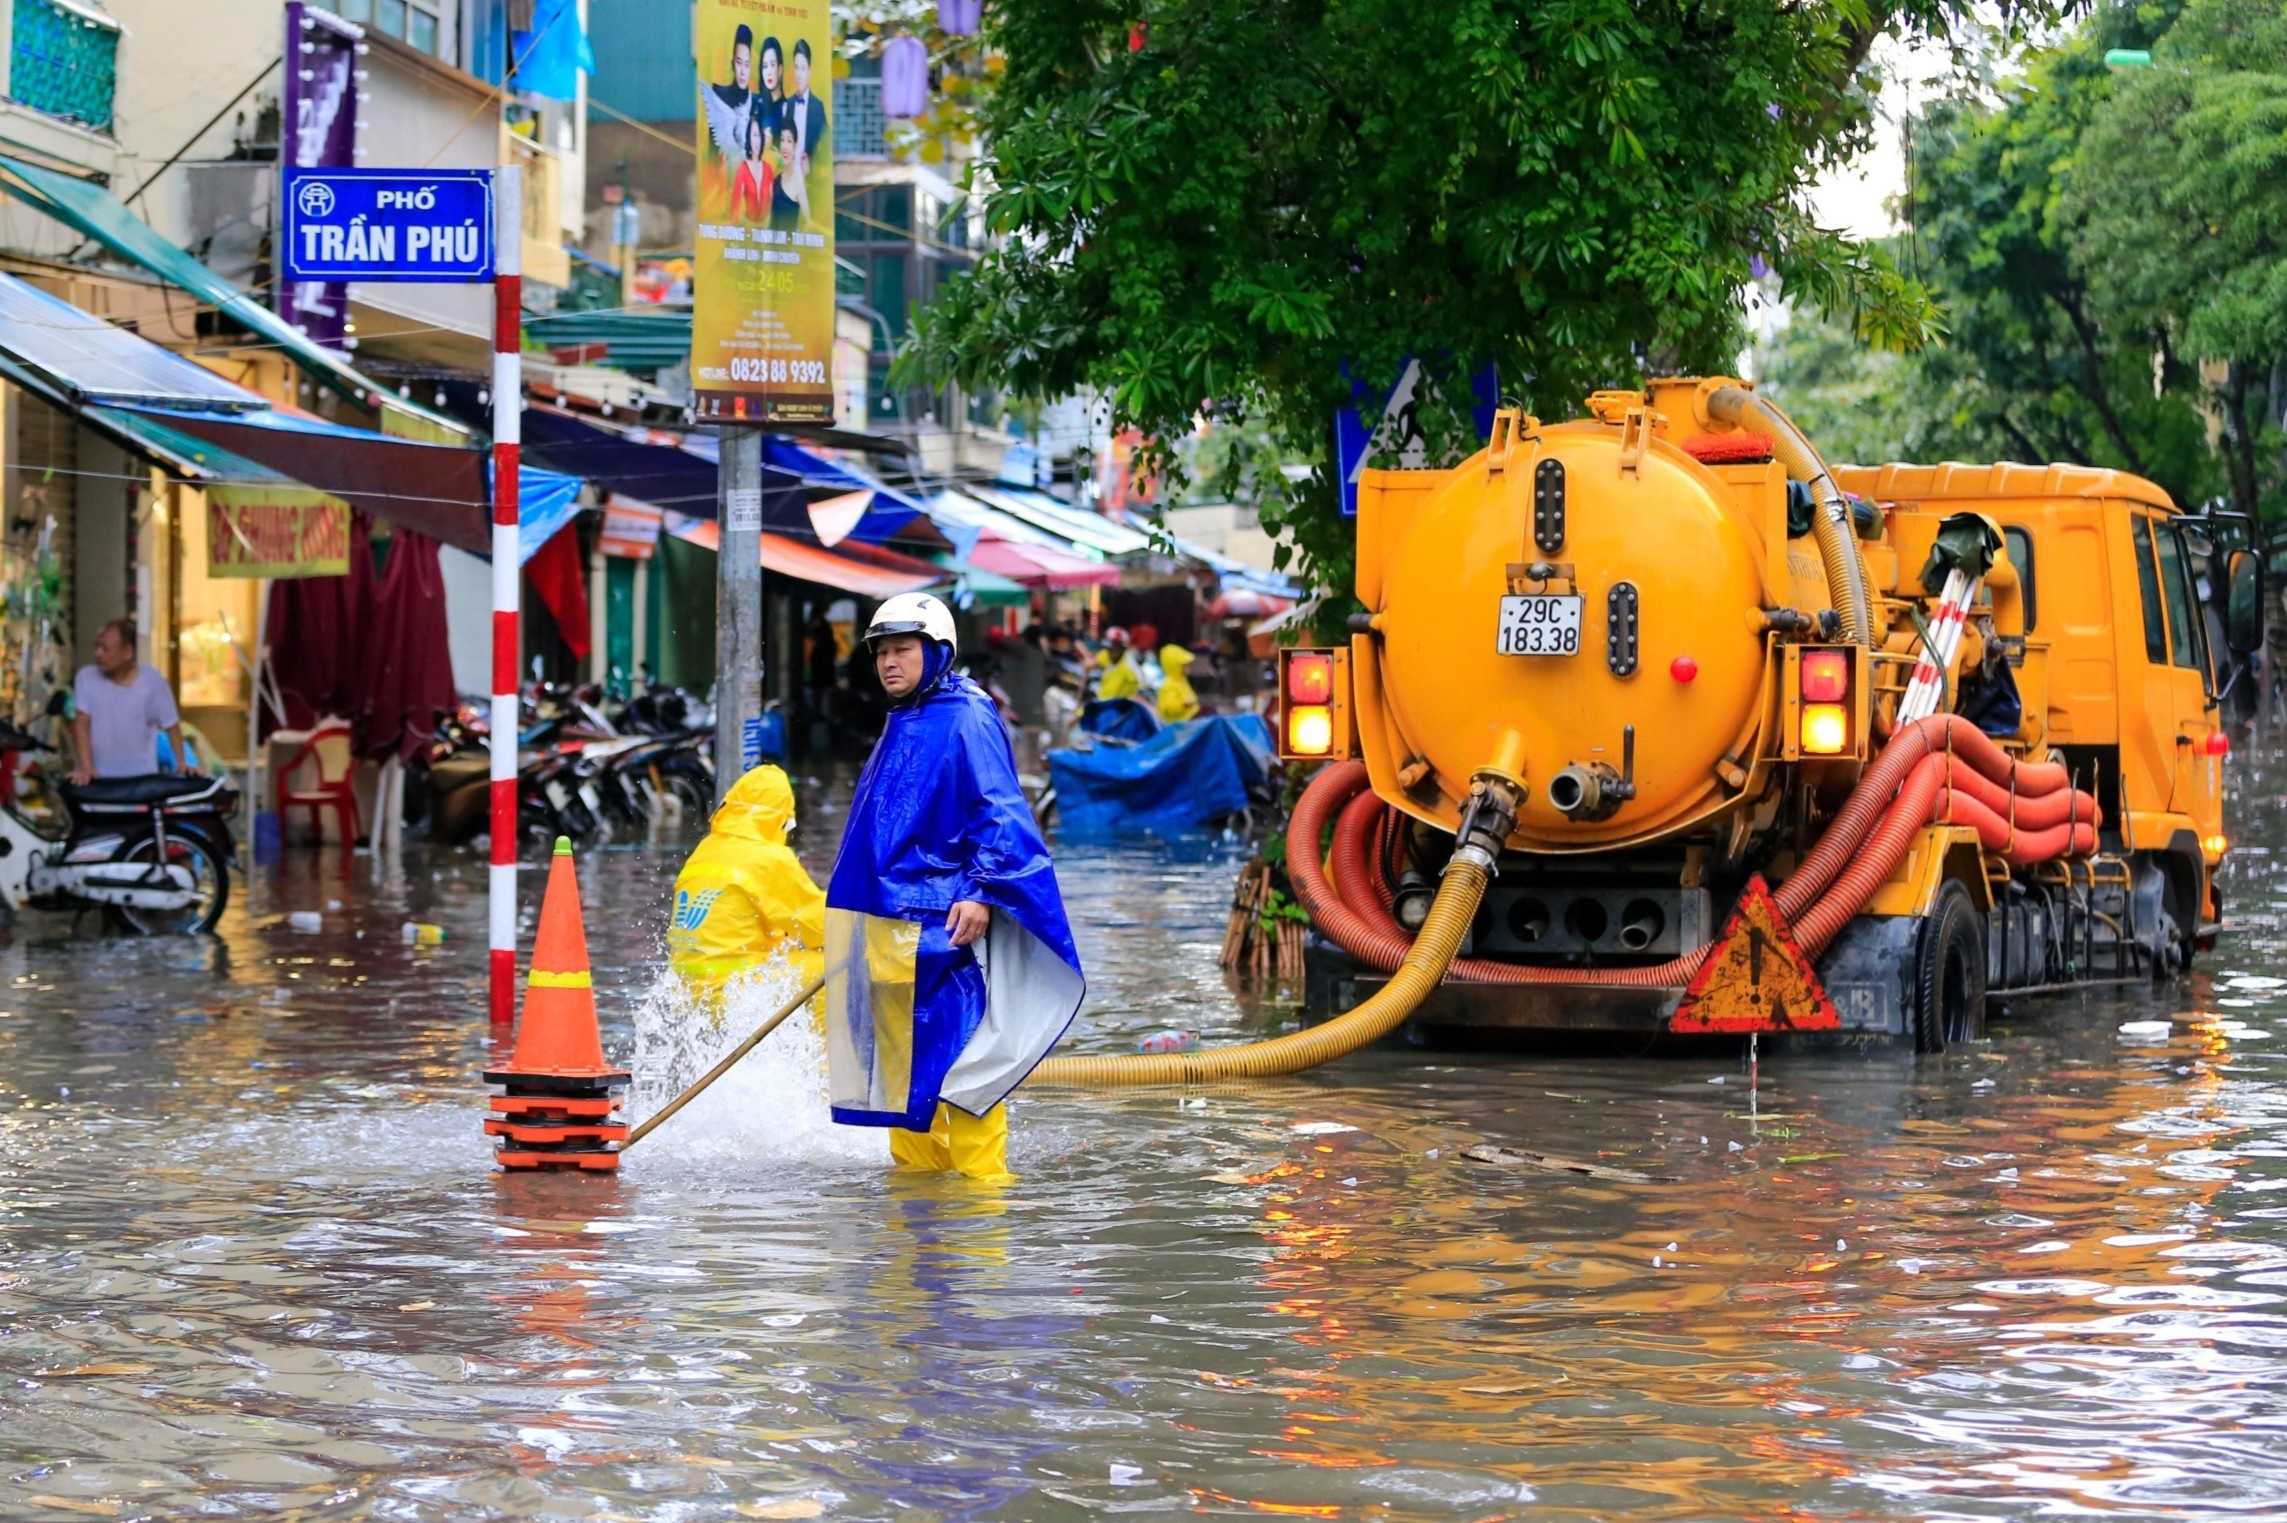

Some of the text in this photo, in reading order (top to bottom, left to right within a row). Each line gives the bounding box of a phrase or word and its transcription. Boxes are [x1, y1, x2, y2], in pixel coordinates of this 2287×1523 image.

[376, 185, 439, 210] PHỐ
[300, 213, 478, 263] TRẦN PHÚ
[731, 357, 769, 382] 0823
[770, 359, 788, 383] 88
[790, 360, 826, 384] 9392
[1518, 598, 1562, 624] 29C
[1503, 626, 1577, 653] 183.38
